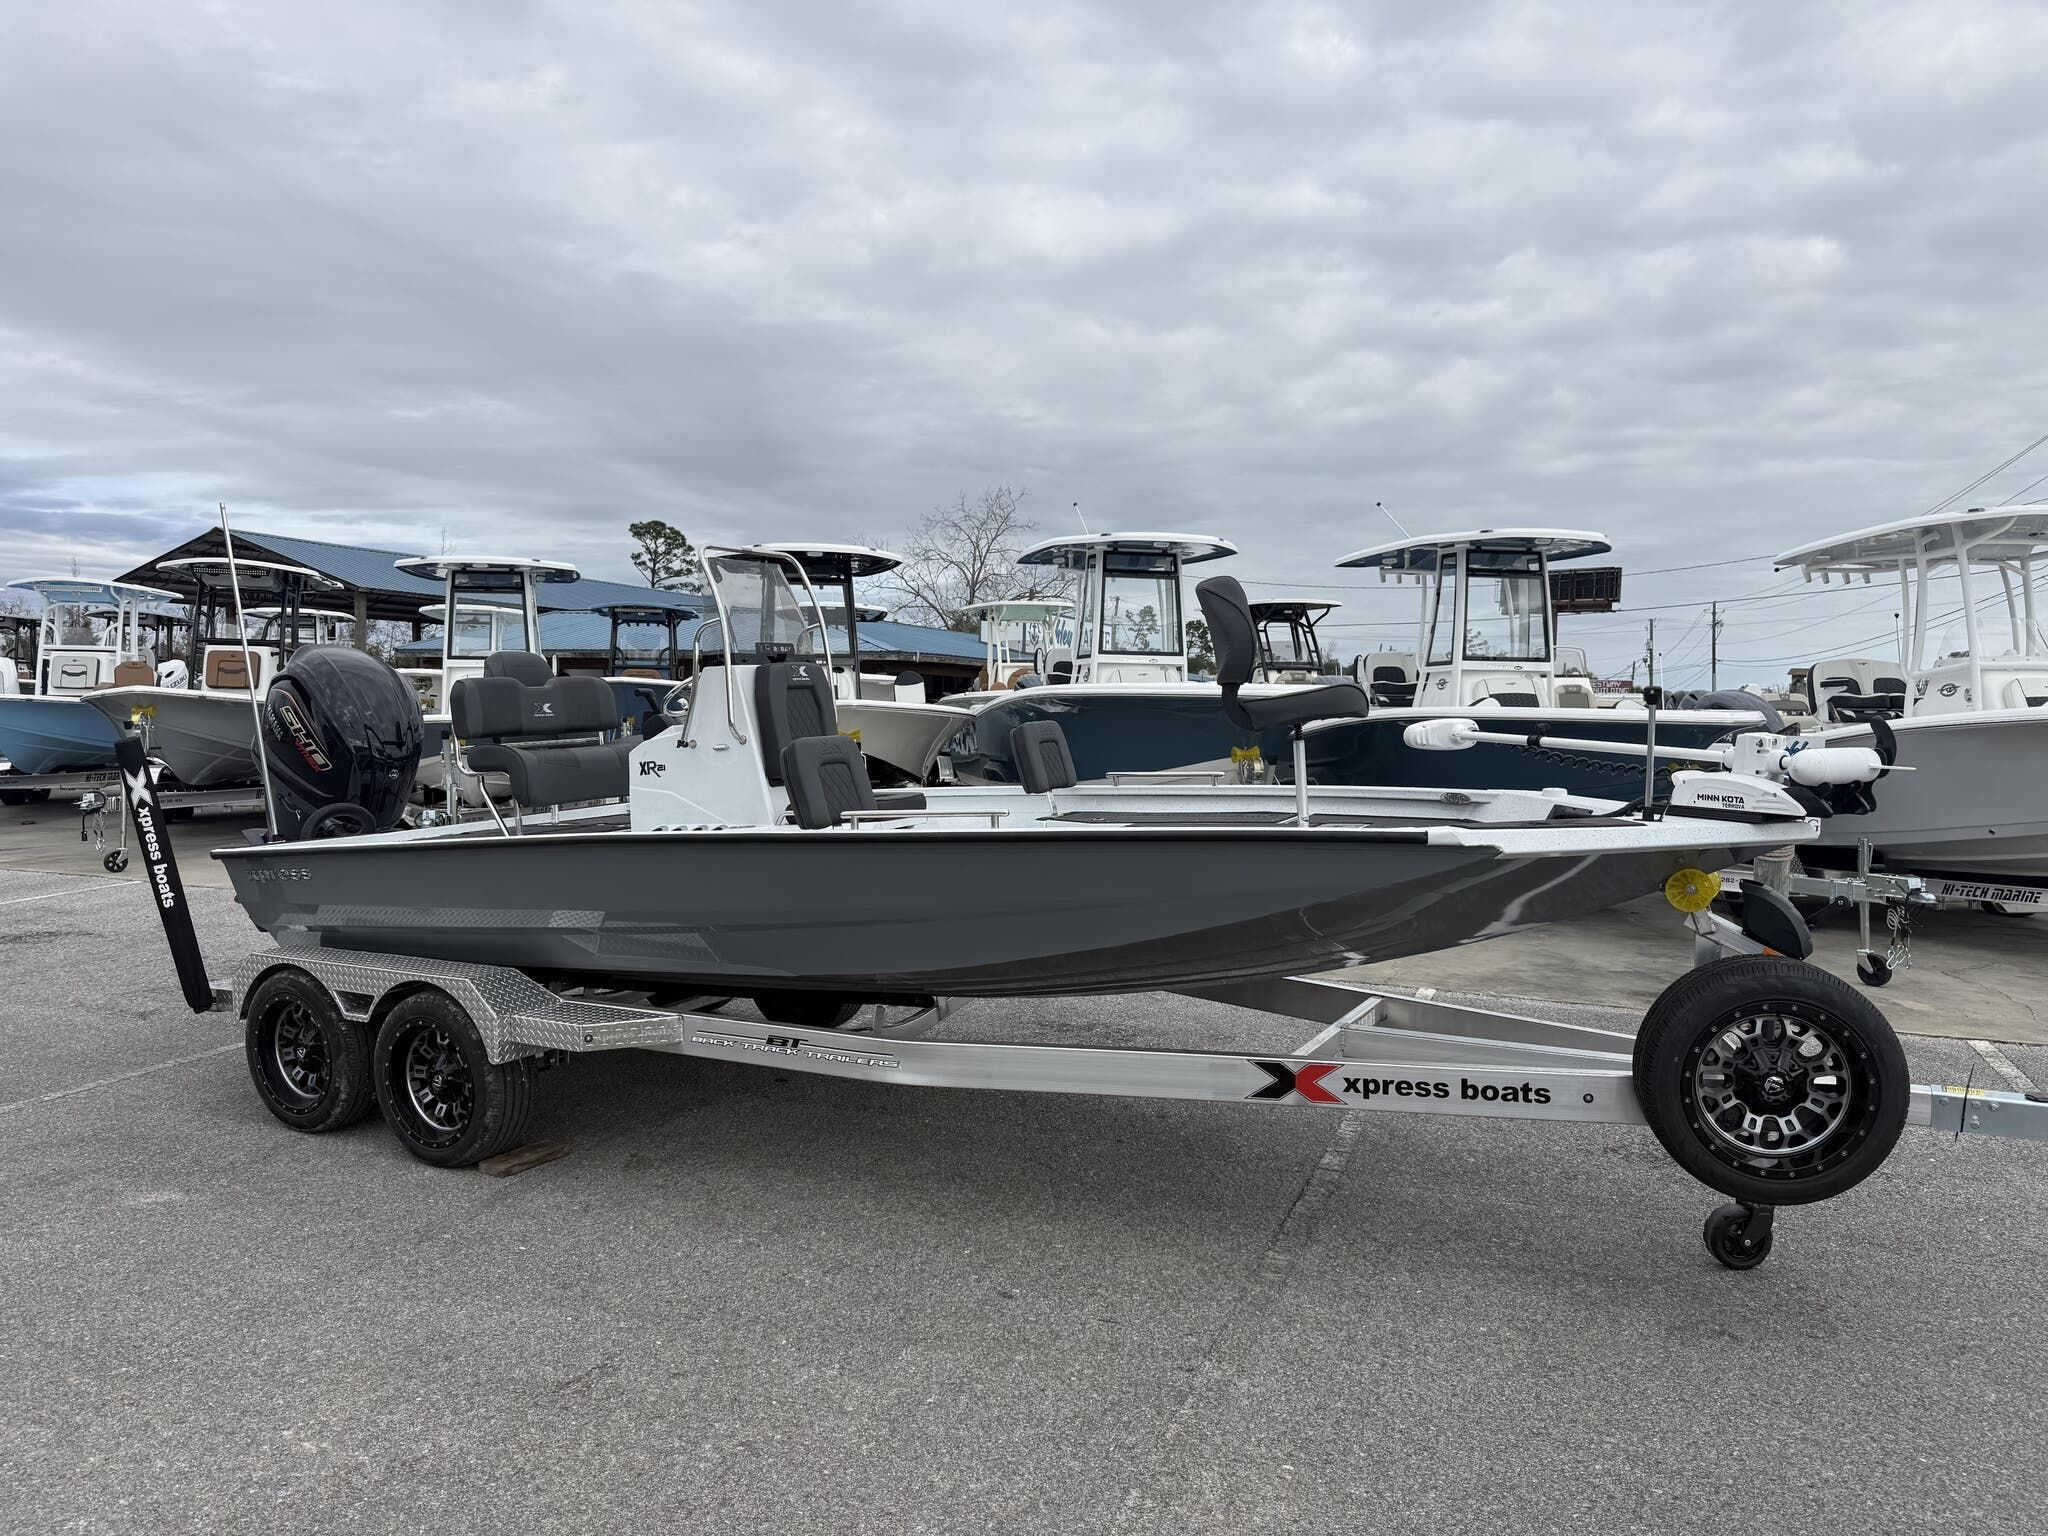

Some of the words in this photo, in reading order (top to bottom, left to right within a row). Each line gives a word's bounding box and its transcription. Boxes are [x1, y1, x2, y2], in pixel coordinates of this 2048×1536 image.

[280, 706, 333, 772] SHO
[1697, 793, 1720, 802] MINN
[1721, 795, 1745, 805] KOTA
[138, 806, 162, 862] xpress
[153, 863, 176, 910] boats
[1941, 883, 1990, 899] HI-TECH
[1990, 888, 2043, 904] MARINE
[691, 1036, 737, 1047] BACK
[741, 1042, 801, 1056] TRACK
[804, 1051, 901, 1068] TRAILERS
[766, 1035, 808, 1049] BT
[1343, 1076, 1450, 1099] xpress
[1461, 1078, 1552, 1105] boats
